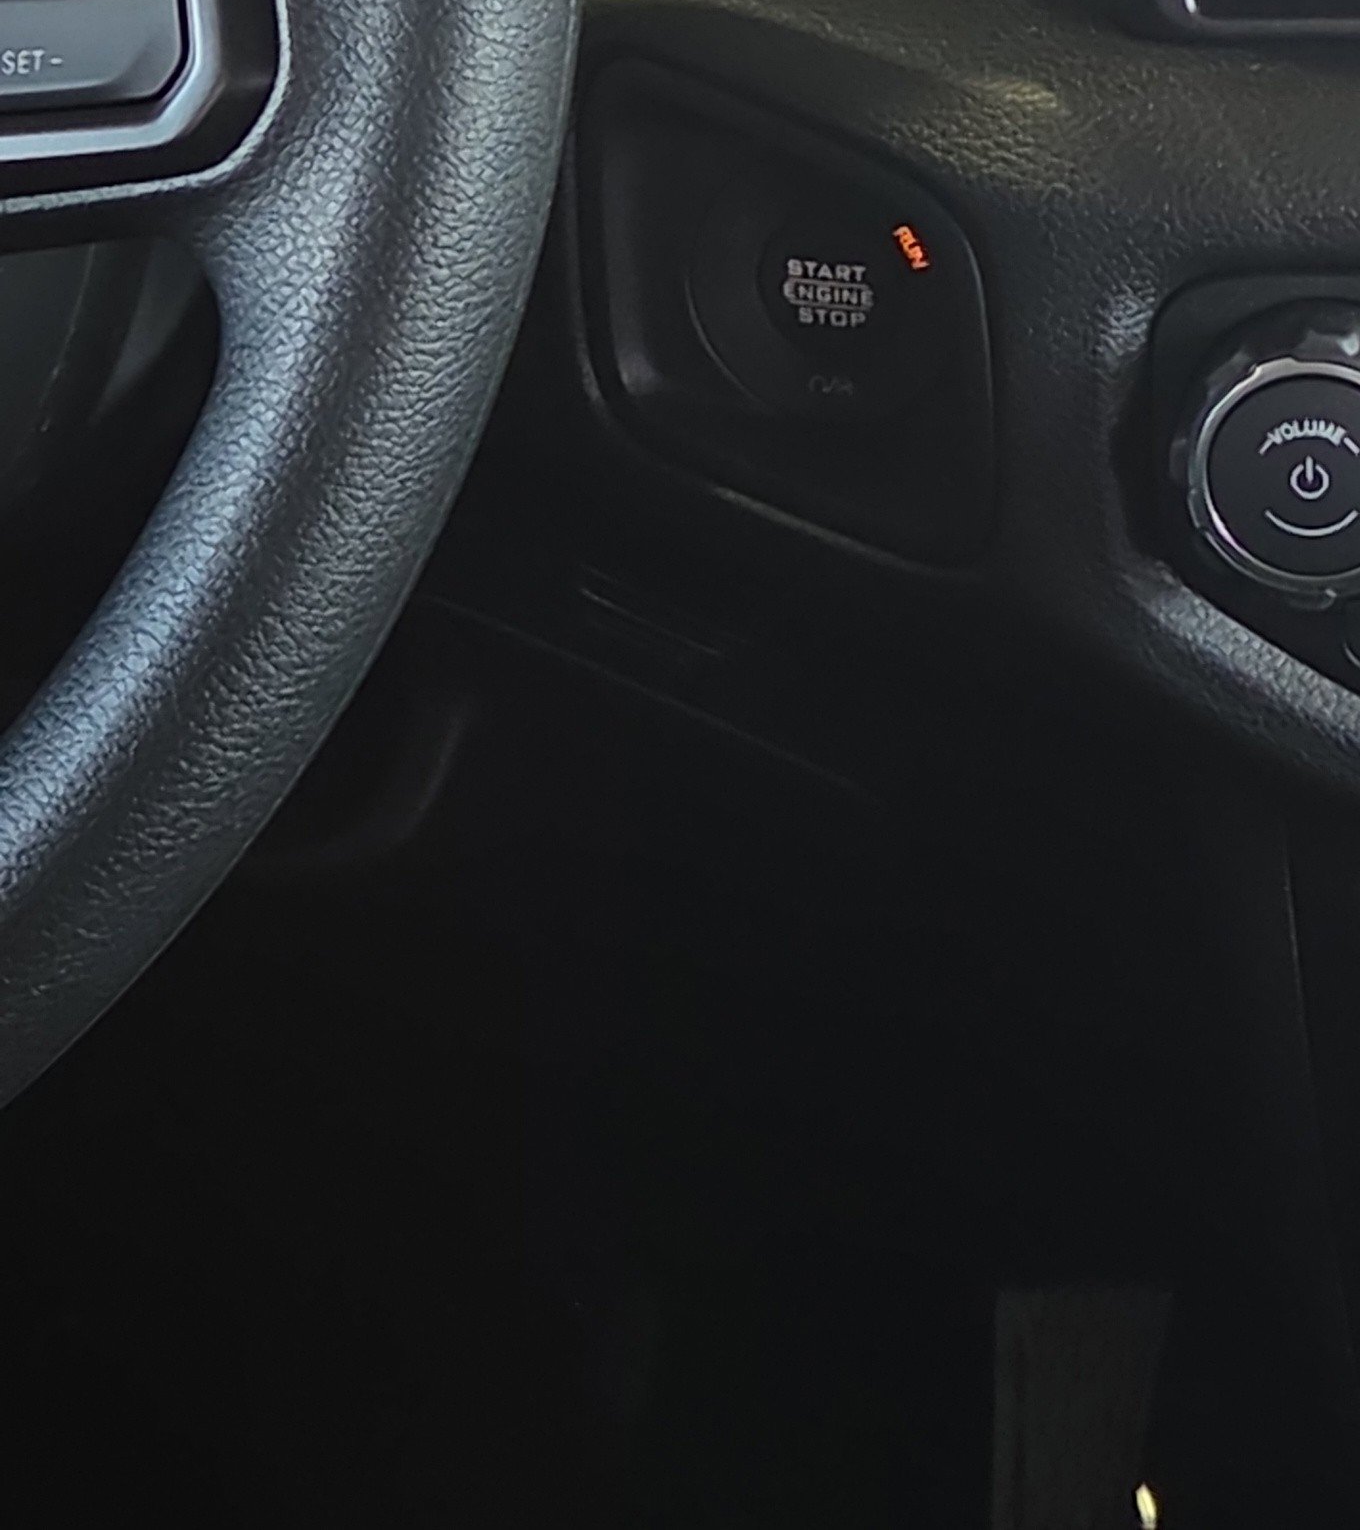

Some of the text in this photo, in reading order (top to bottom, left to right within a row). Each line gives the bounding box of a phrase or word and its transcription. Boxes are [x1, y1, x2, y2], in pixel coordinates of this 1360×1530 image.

[787, 258, 867, 283] START
[786, 283, 873, 307] ENGINE
[799, 307, 867, 327] STOP
[1268, 418, 1349, 447] VOLUME
